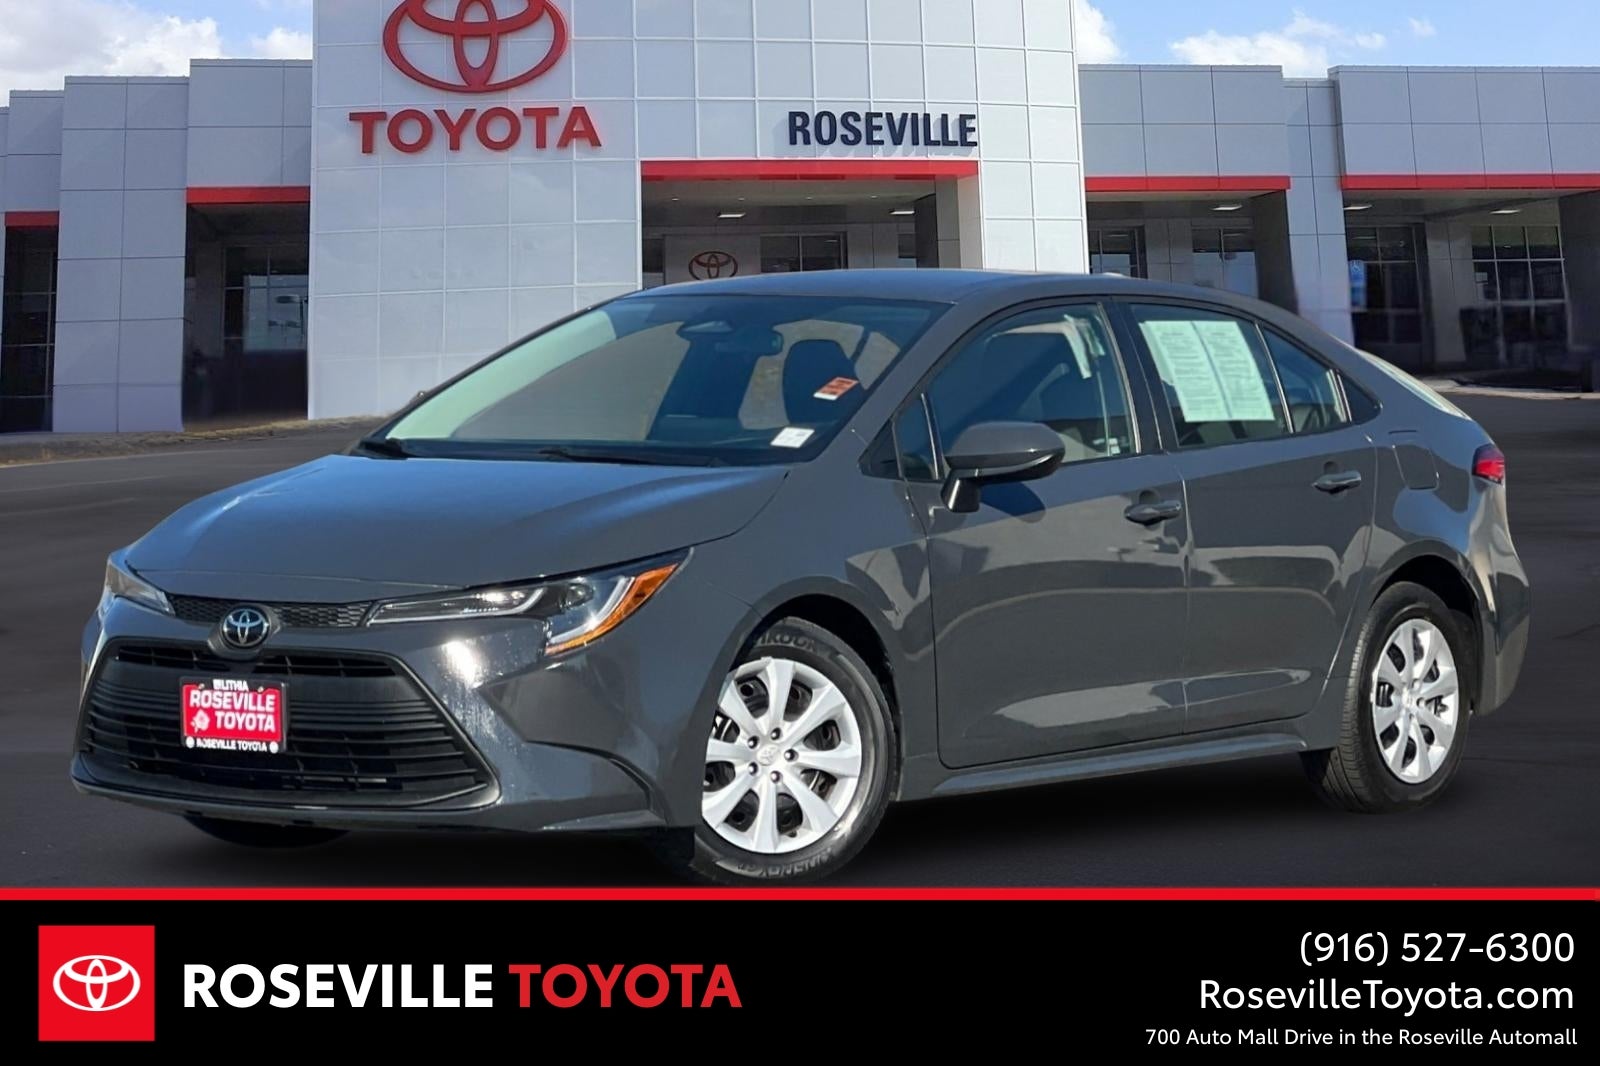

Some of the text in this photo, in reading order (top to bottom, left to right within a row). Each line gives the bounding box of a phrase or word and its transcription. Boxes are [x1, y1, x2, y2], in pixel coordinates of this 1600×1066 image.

[350, 106, 602, 154] TOYOTA
[788, 110, 978, 147] ROSEVILLE
[189, 689, 276, 713] ROSEVILLE
[215, 710, 276, 733] TOYOTA
[196, 737, 268, 753] ROSEVILLE TOYOTA
